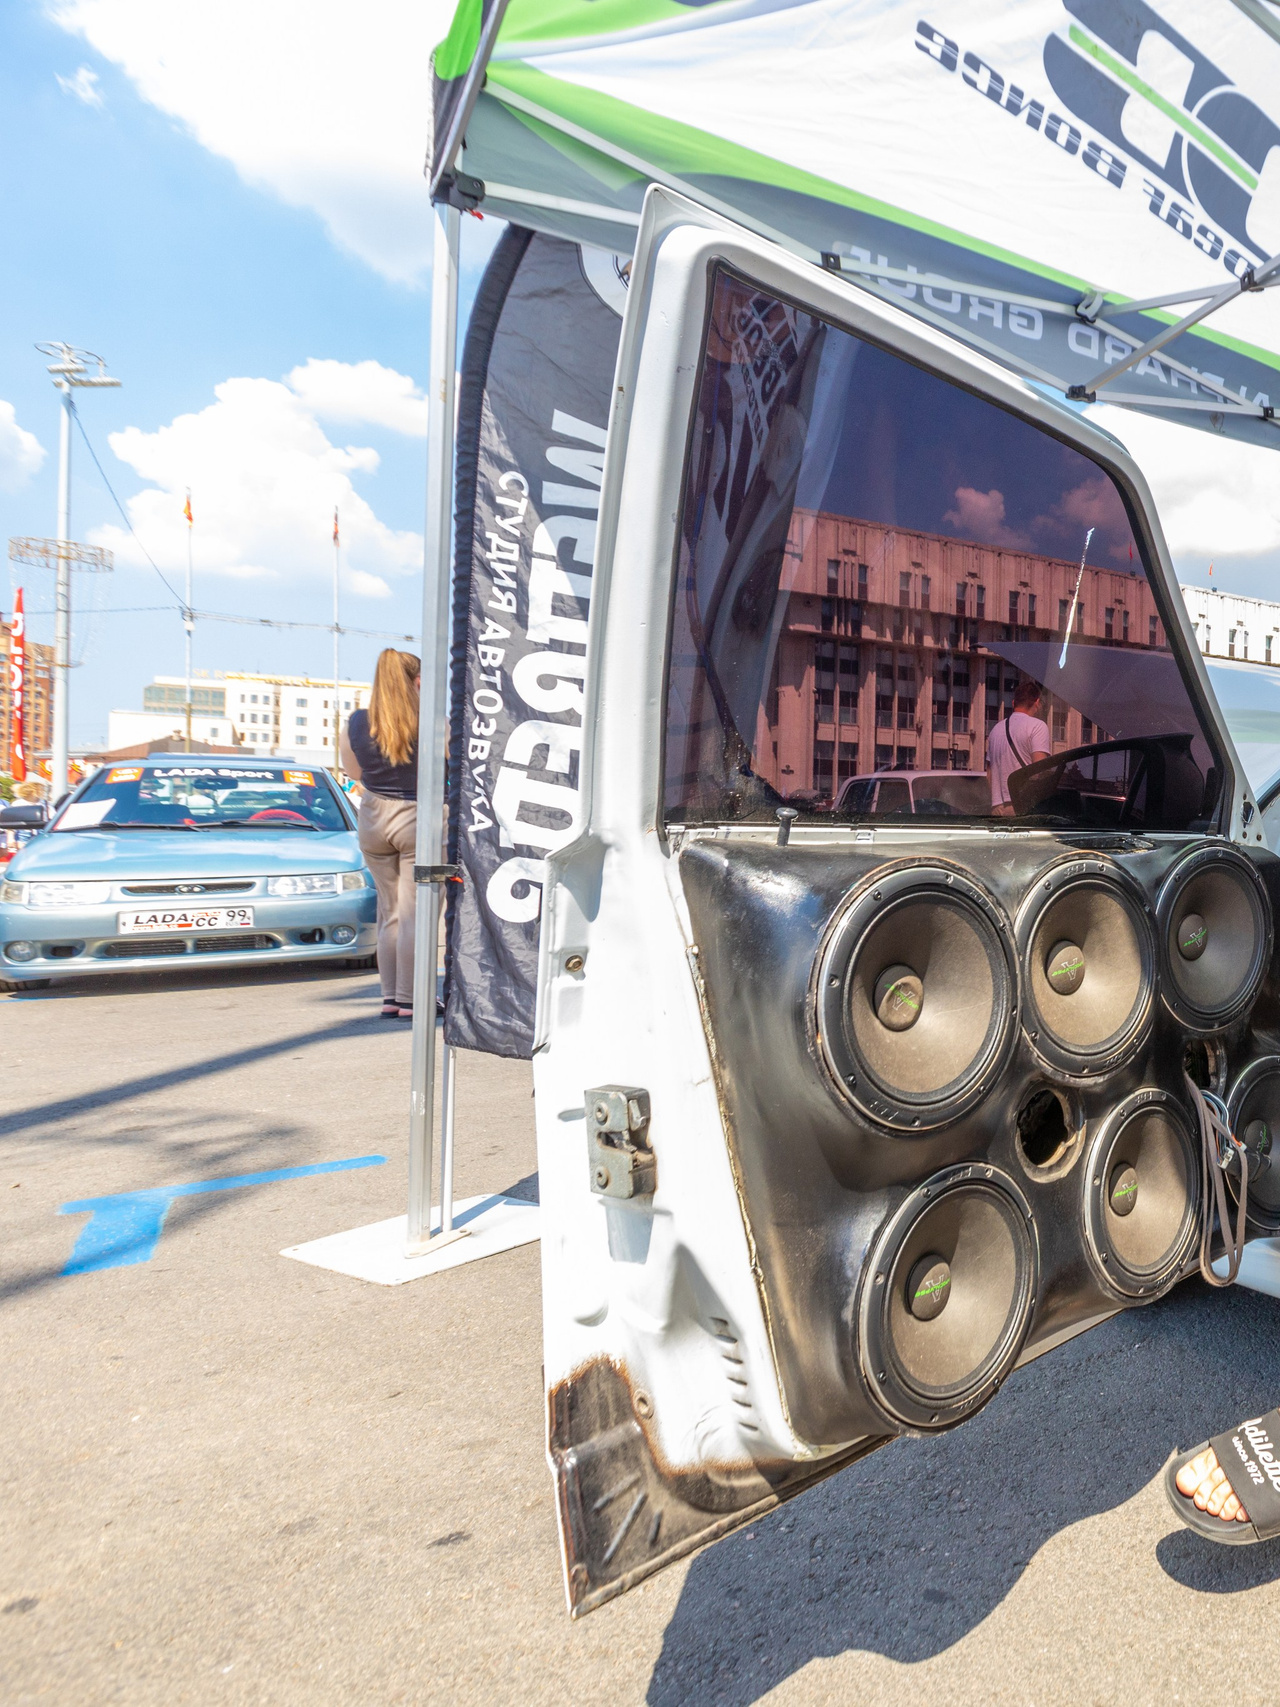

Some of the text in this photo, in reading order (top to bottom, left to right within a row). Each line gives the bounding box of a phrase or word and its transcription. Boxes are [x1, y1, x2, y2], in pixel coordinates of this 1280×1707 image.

[467, 470, 530, 833] СТУДИЯ АВТОЗВУКА
[153, 767, 275, 780] LADA Sport
[1244, 1460, 1265, 1485] 1972
